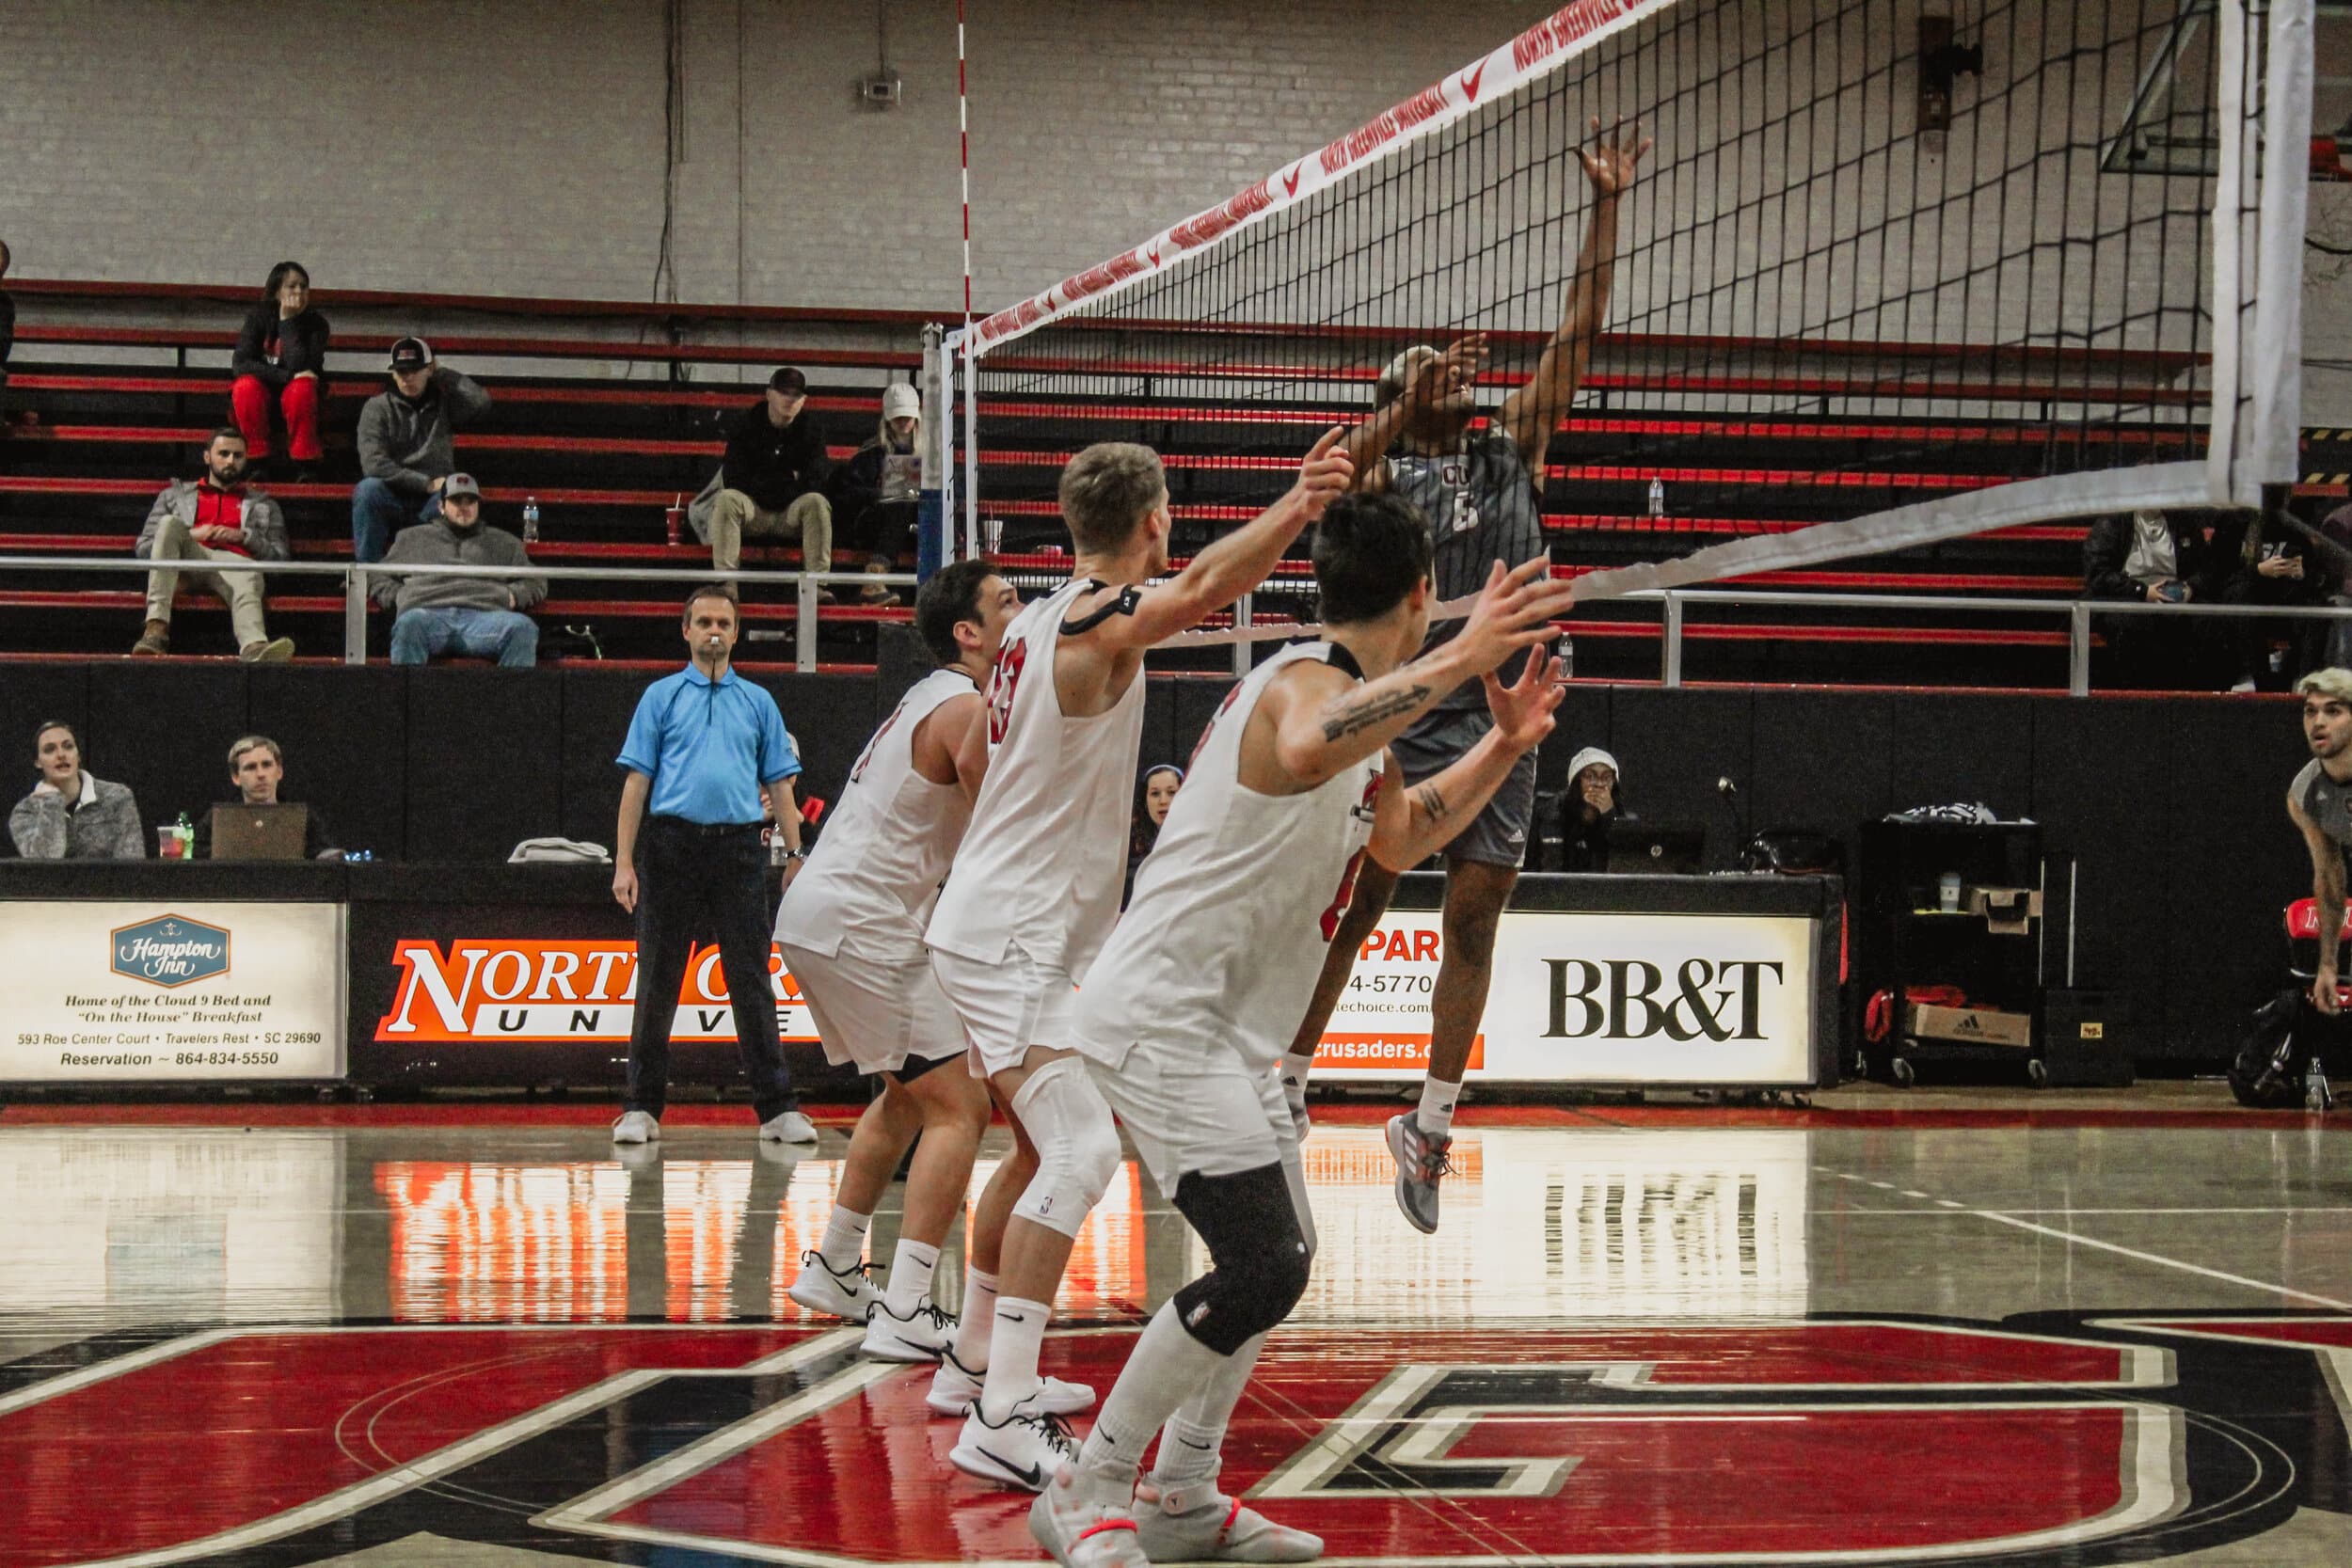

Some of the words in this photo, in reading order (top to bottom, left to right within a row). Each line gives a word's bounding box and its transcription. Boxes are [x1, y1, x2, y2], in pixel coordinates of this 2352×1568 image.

[1513, 20, 1553, 72] NORTH
[120, 938, 221, 961] Hampton
[144, 956, 196, 977] Inn
[65, 995, 107, 1006] Home
[111, 995, 125, 1008] of
[128, 995, 151, 1006] the
[154, 995, 197, 1006] Cloud
[200, 995, 209, 1006] 9
[213, 995, 240, 1006] Bed
[243, 995, 271, 1006] and
[1540, 958, 1784, 1041] BB&T
[110, 1012, 133, 1022] the
[192, 1011, 262, 1023] Breakfast
[18, 1034, 40, 1045] 593
[43, 1034, 68, 1045] Roe
[72, 1034, 112, 1045] Center
[116, 1033, 151, 1044] Court
[166, 1033, 218, 1044] Travelers
[222, 1033, 249, 1044] Rest
[263, 1032, 281, 1044] SC
[284, 1032, 321, 1044] 29690
[60, 1053, 151, 1066] Reservation
[175, 1052, 278, 1065] 864-834-5550
